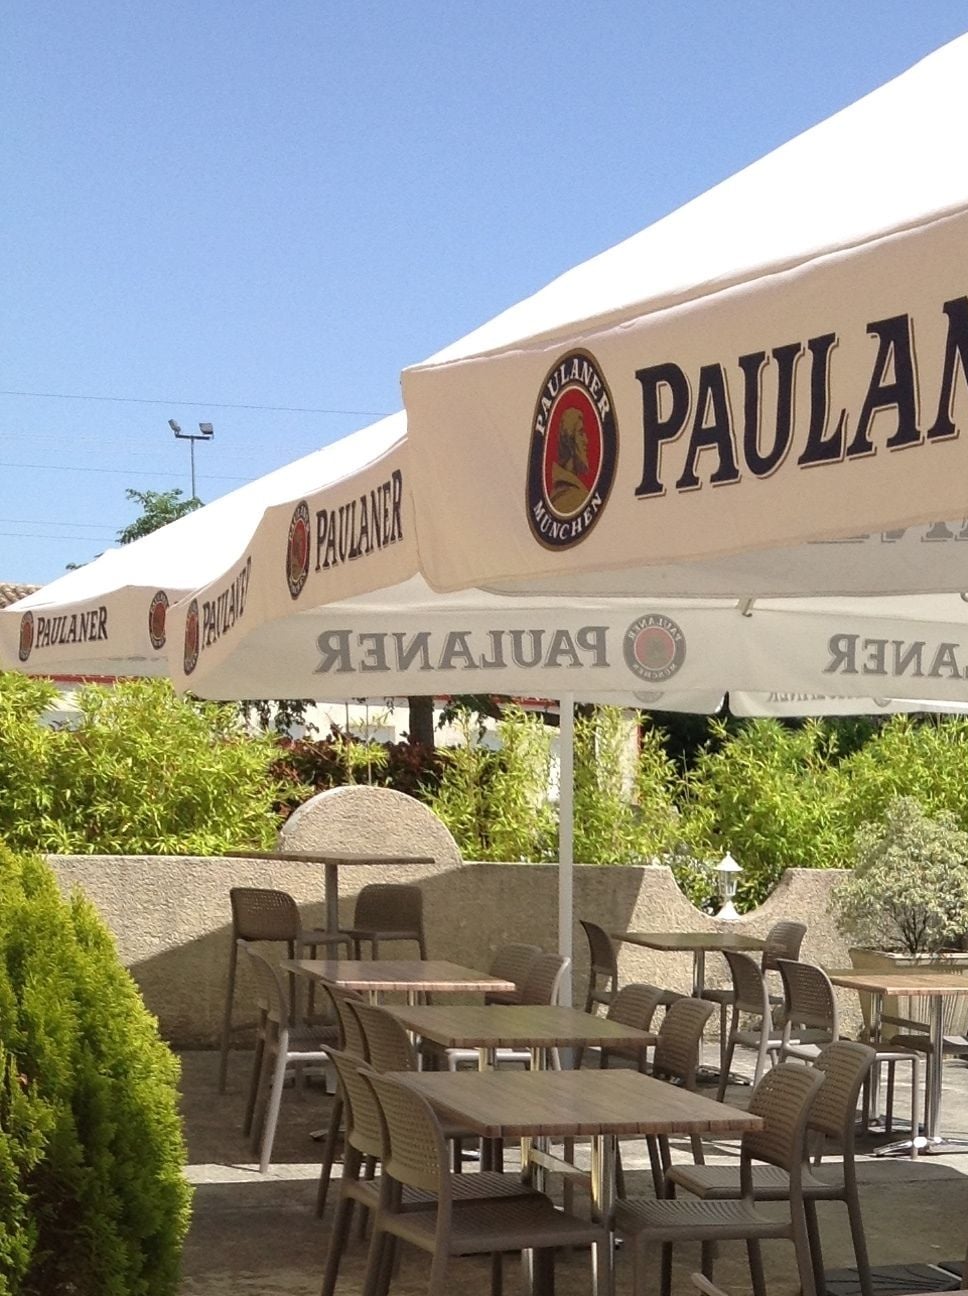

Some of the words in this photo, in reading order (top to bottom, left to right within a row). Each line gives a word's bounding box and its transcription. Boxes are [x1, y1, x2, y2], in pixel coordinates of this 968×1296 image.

[535, 358, 610, 436] PAULANER
[315, 469, 403, 573] PAULANER
[35, 606, 108, 649] PAULANER
